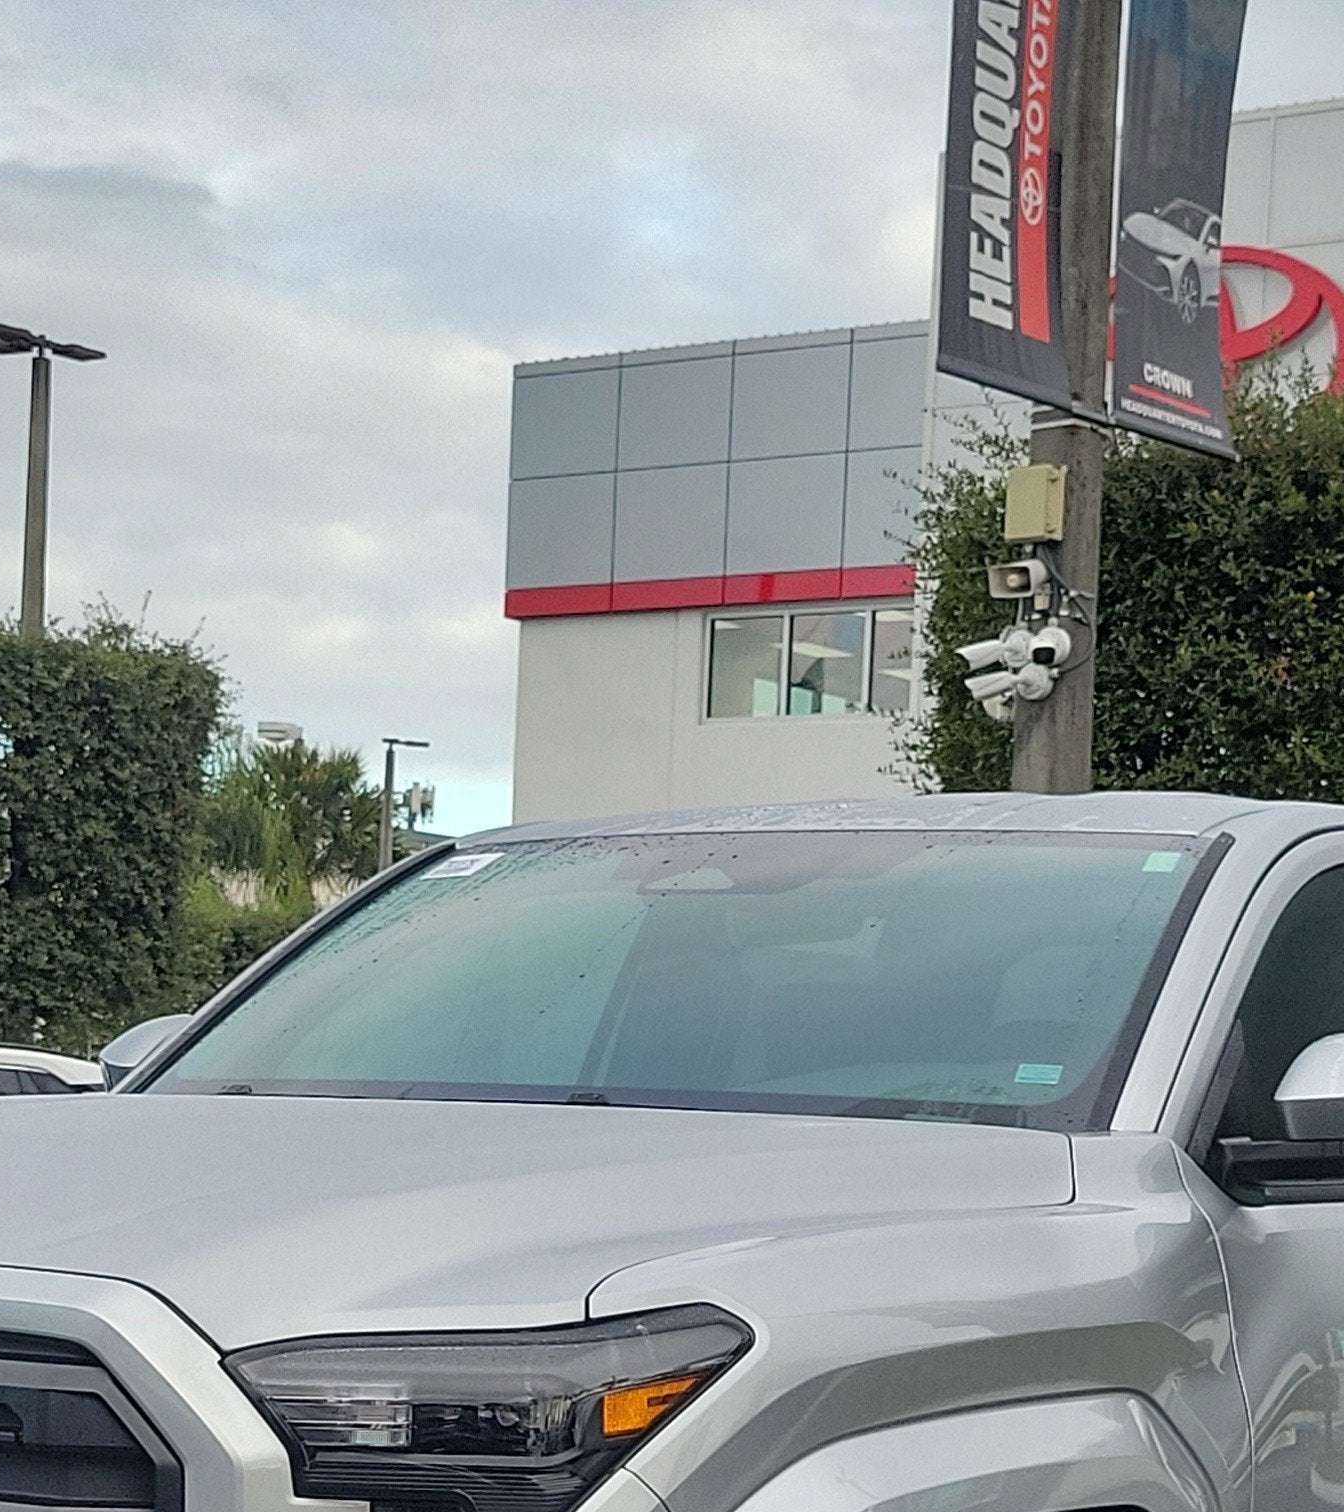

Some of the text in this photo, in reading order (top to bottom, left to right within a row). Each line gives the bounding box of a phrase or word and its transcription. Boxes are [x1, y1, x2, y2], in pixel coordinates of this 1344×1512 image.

[1023, 0, 1056, 160] TOYOT
[968, 0, 1023, 331] HEADQUA
[1143, 362, 1194, 399] CROWN
